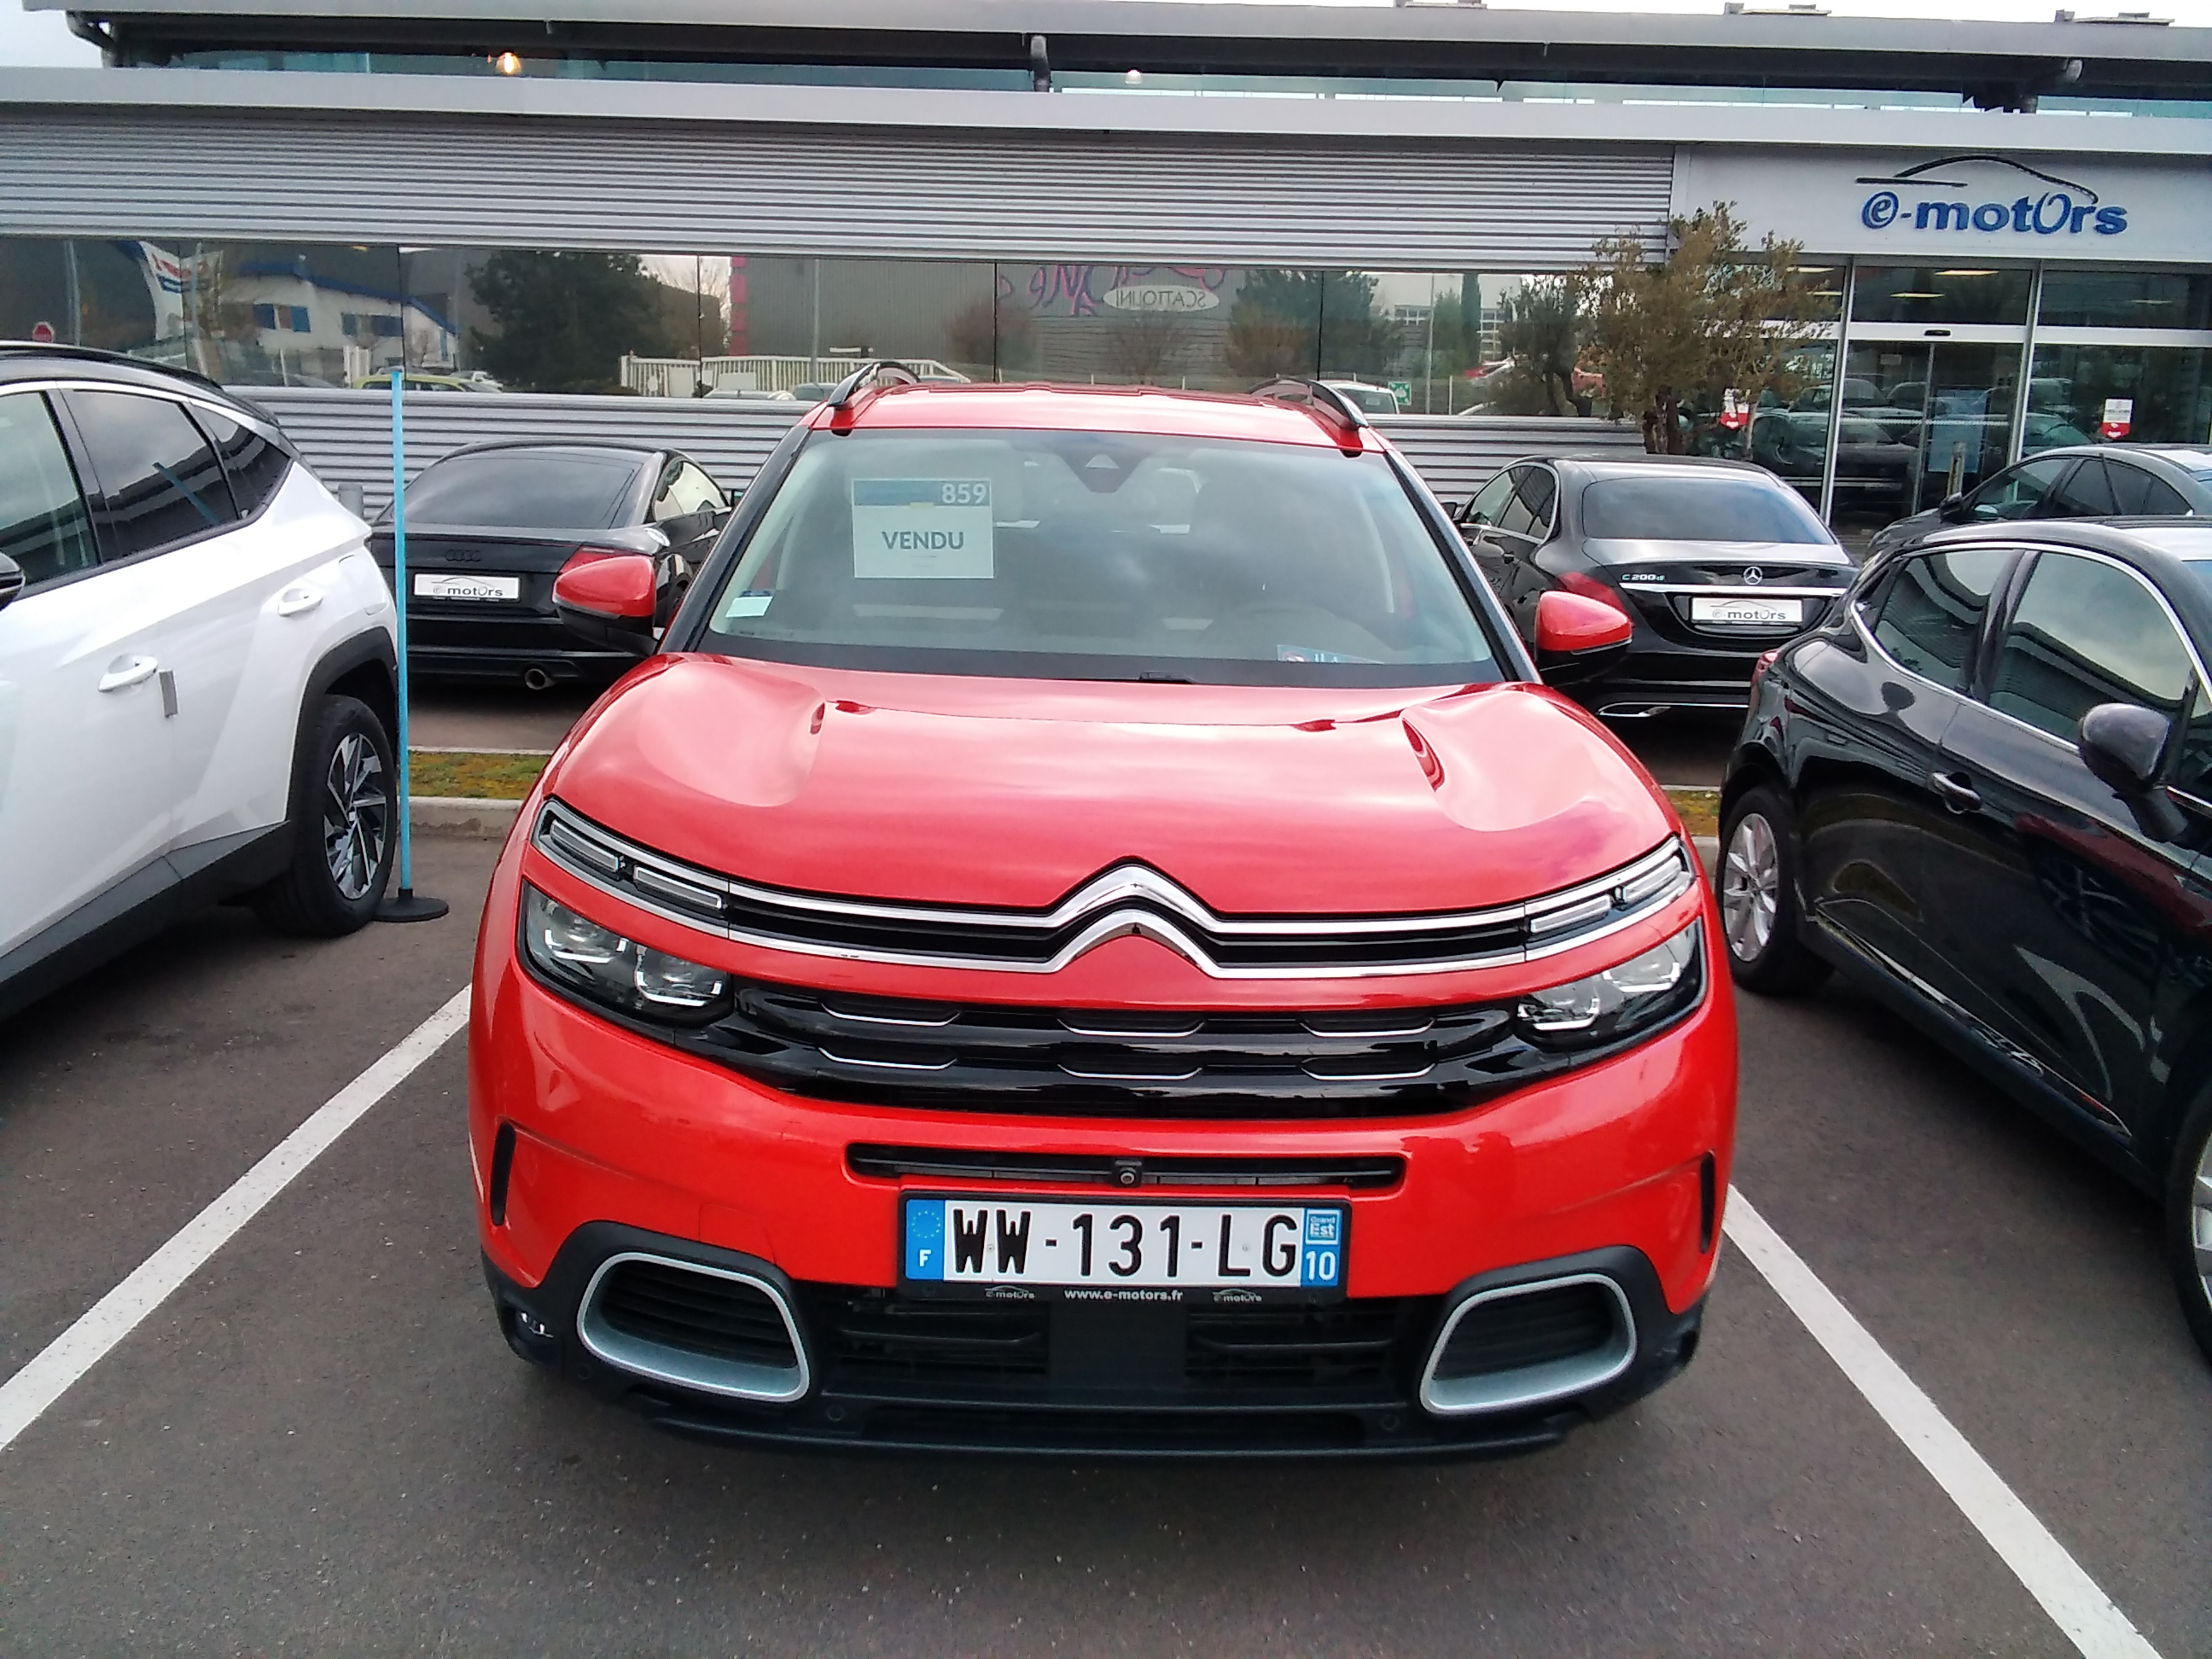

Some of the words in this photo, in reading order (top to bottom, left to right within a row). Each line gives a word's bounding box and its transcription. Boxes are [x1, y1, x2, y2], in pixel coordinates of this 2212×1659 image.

[941, 483, 987, 504] 859
[882, 531, 964, 550] VENDU
[1310, 1223, 1336, 1237] Est
[952, 1208, 1299, 1278] WW-131-LG
[919, 1249, 932, 1267] F
[1306, 1251, 1336, 1281] 10
[1063, 1289, 1184, 1301] www.e-motors.fr
